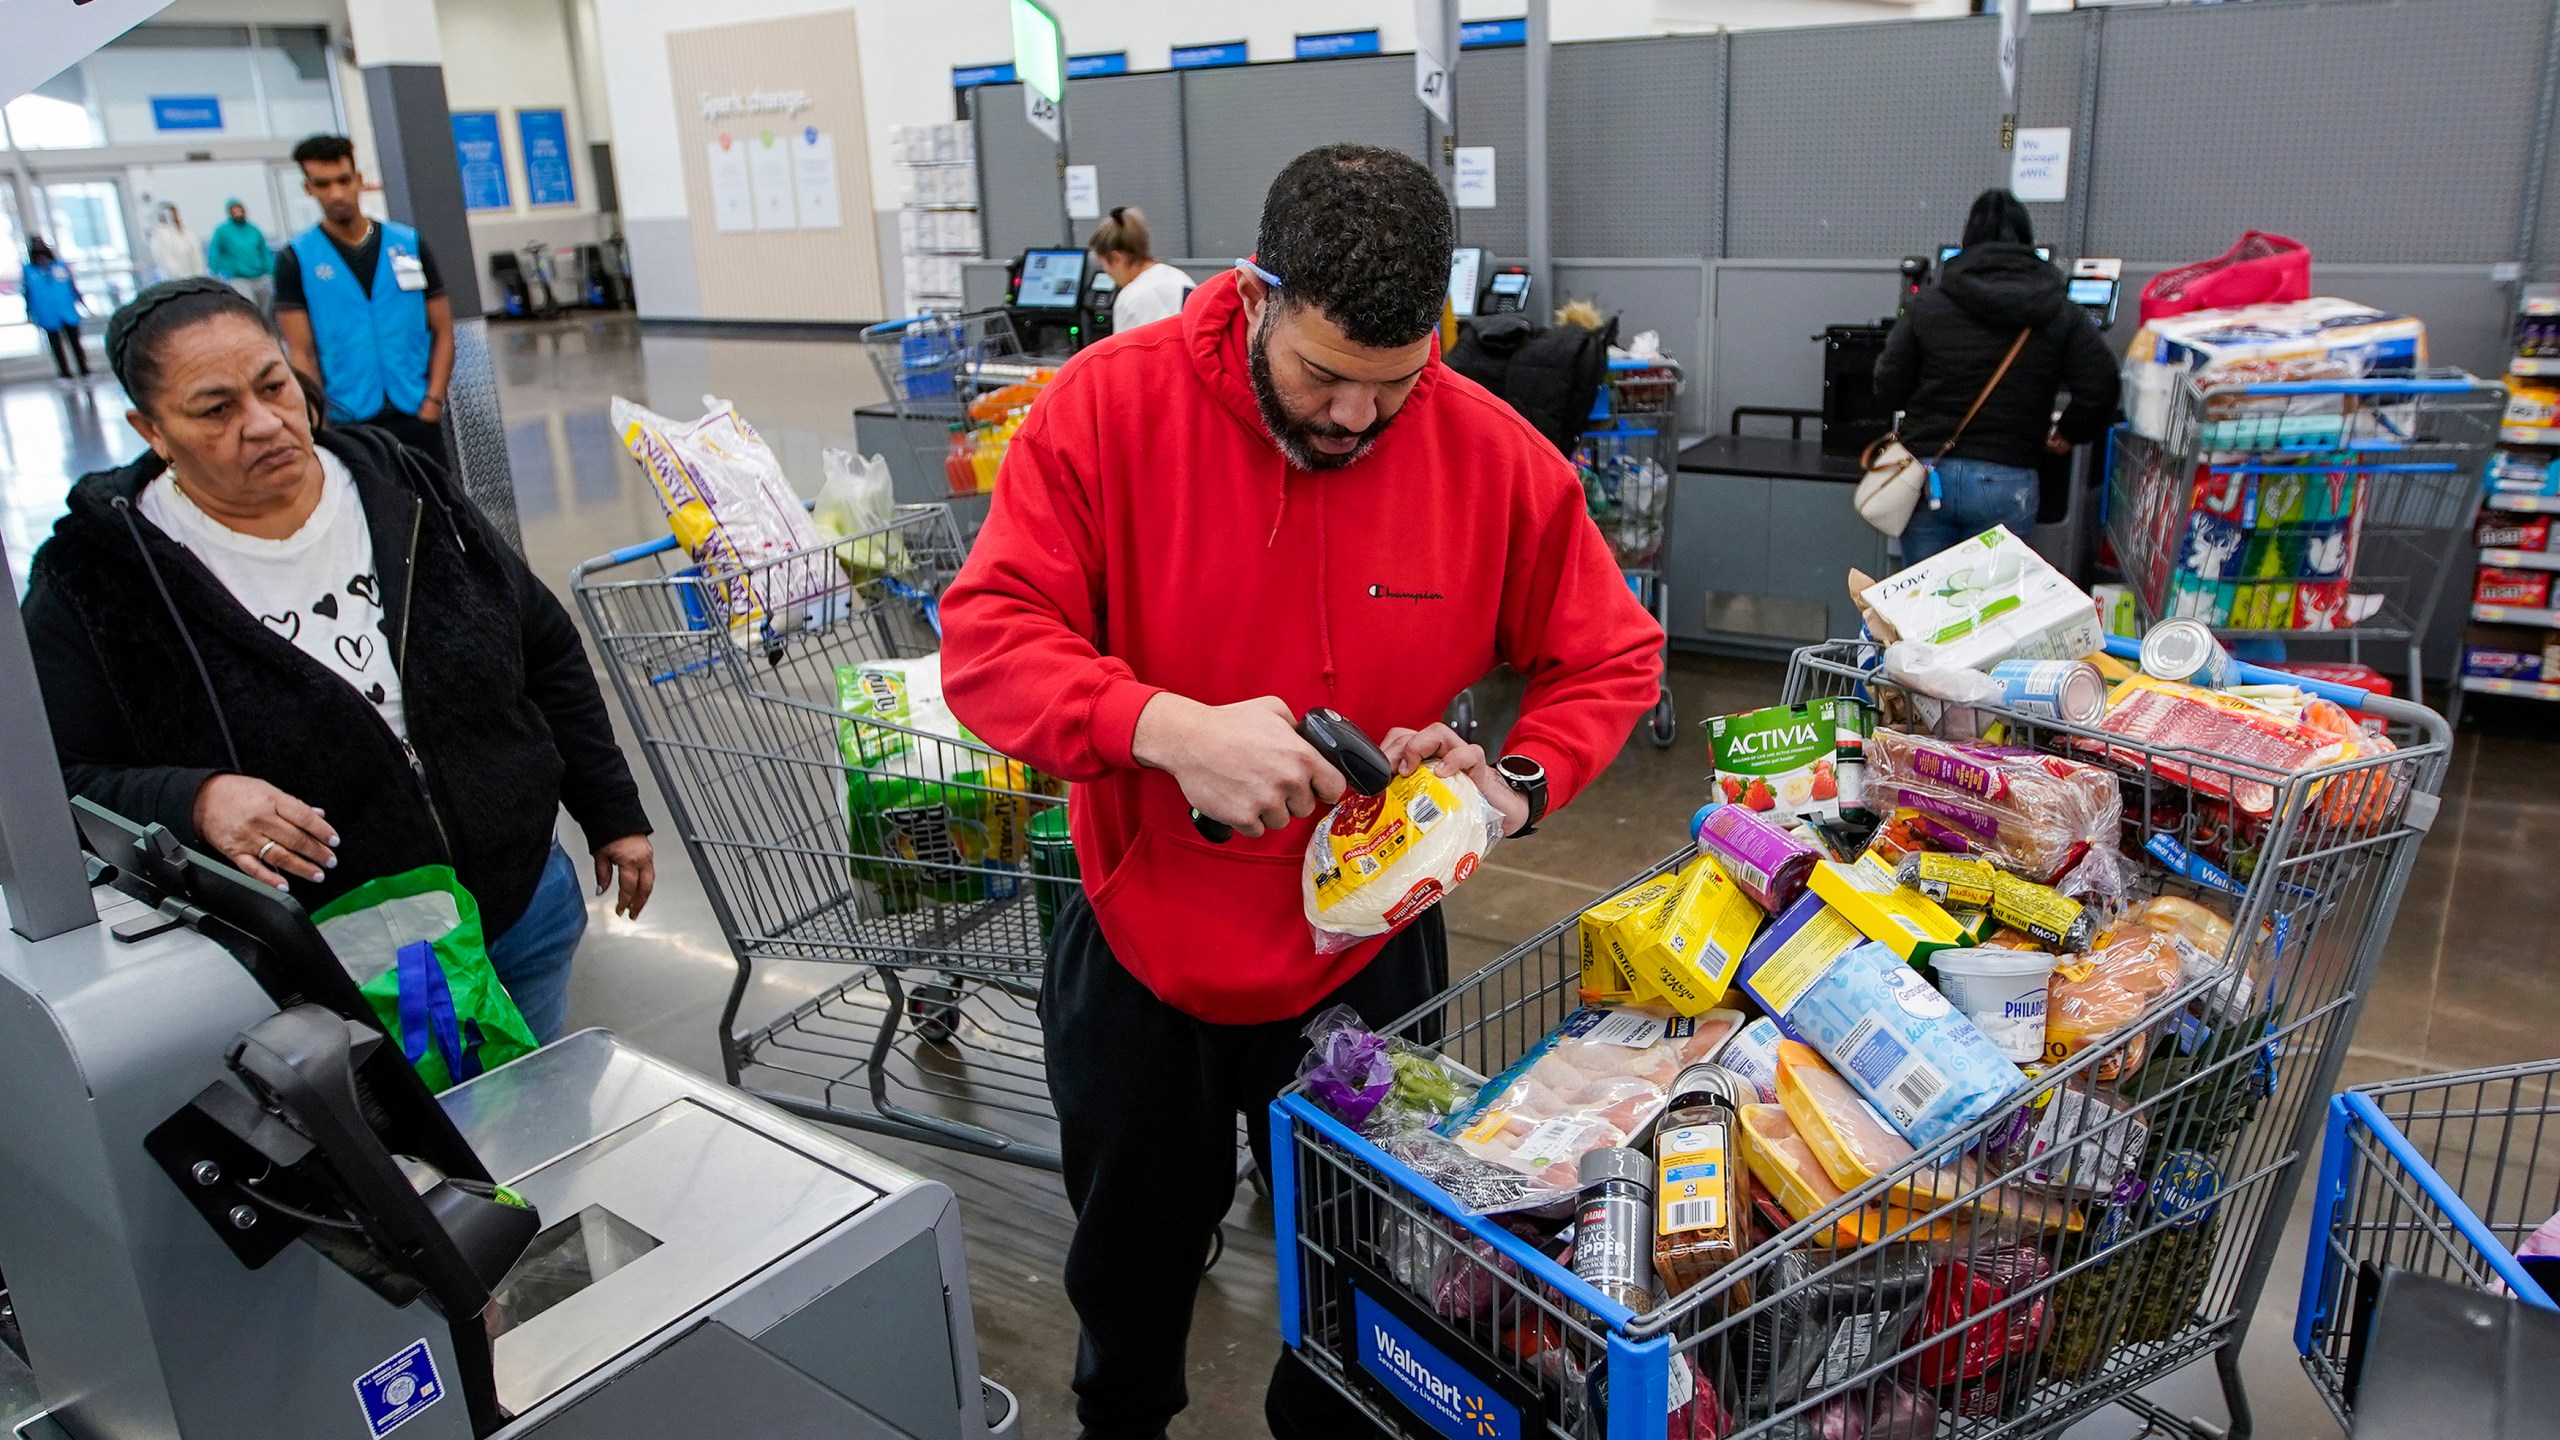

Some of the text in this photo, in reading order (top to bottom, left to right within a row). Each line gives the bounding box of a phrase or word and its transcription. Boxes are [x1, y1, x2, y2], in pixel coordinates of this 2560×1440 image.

[1423, 70, 1443, 97] 47
[2022, 139, 2041, 150] We
[2020, 153, 2060, 165] accept
[1367, 583, 1444, 605] Champion
[1882, 568, 1931, 601] Dove
[2080, 627, 2093, 648] Dove
[1727, 722, 1820, 758] ACTIVIA
[2031, 925, 2060, 944] GOYA
[1612, 941, 1637, 983] BUSTELO
[1583, 1208, 1606, 1223] BADIA
[1577, 1230, 1616, 1247] BLACK
[1579, 1222, 1613, 1236] GROUND
[1573, 1241, 1627, 1265] PEPPER
[1374, 1323, 1462, 1413] Walmart
[1377, 1352, 1464, 1427] Save money. Live better.
